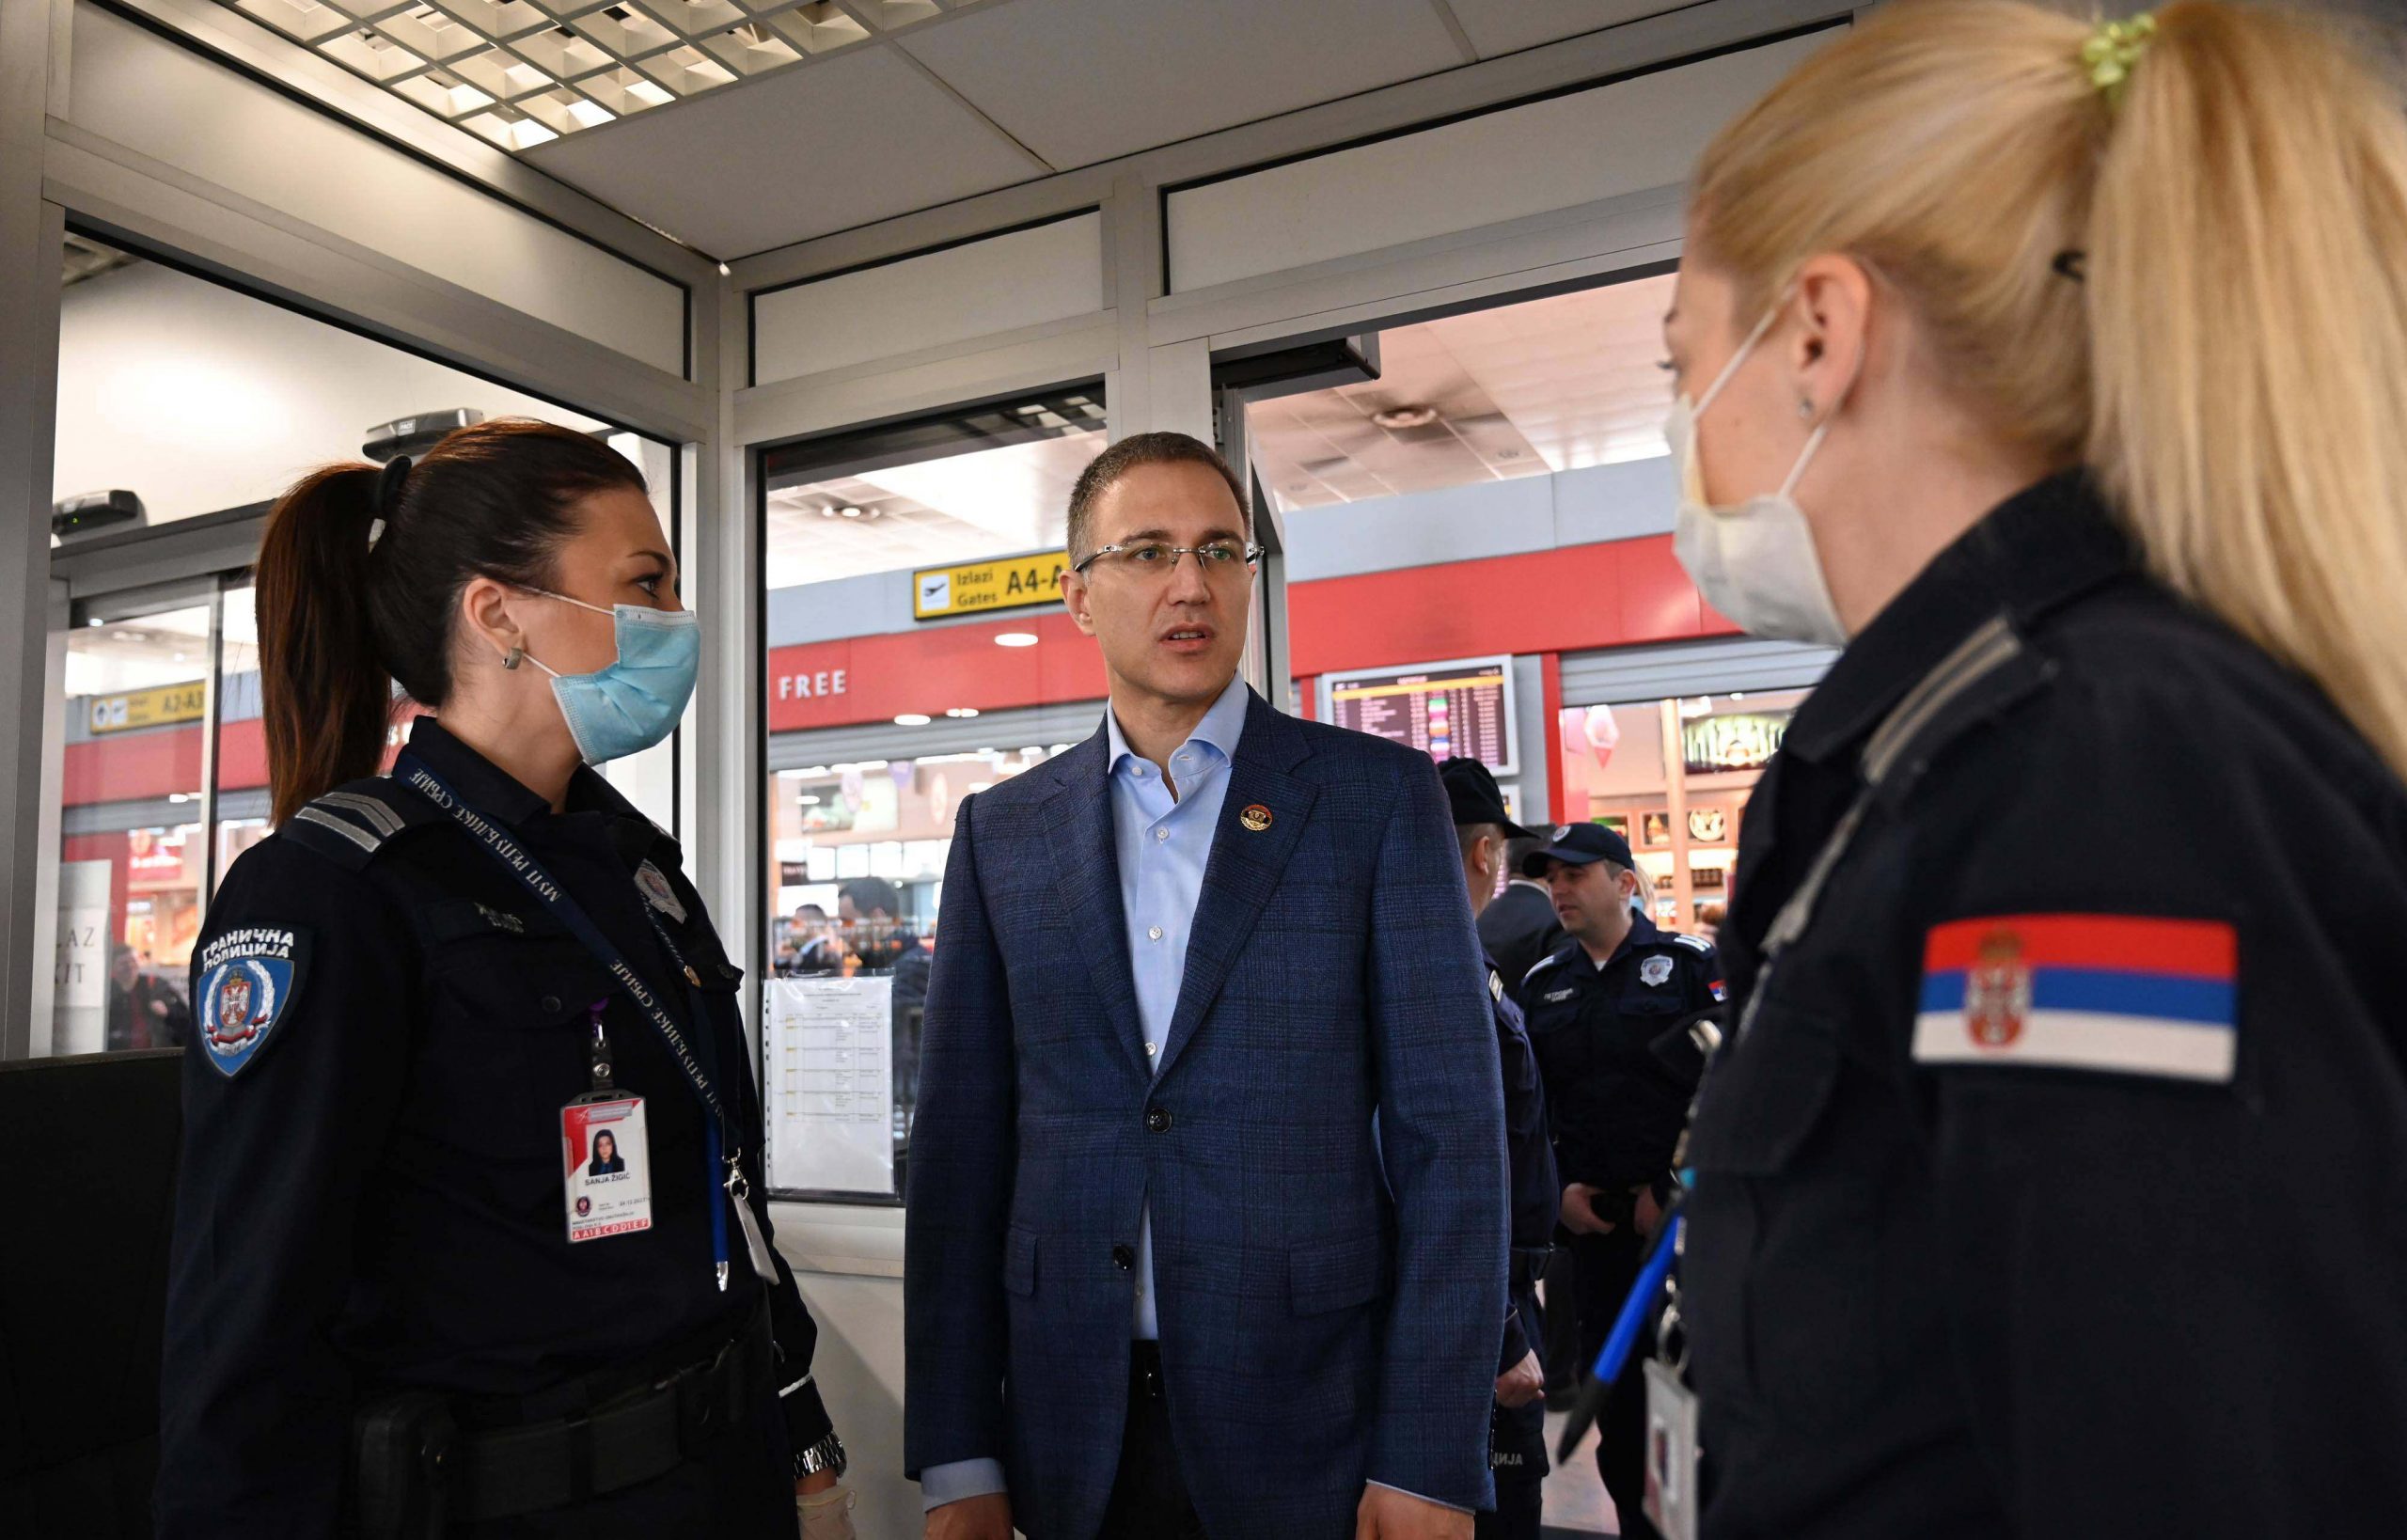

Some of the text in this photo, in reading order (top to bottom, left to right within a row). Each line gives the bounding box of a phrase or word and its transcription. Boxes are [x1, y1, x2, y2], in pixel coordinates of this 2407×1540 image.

[956, 568, 994, 587] Izlazi
[957, 591, 998, 607] Gates
[779, 669, 847, 700] FREE
[408, 767, 562, 904] МУП РЕПУБЛИКЕ СРБИЈЕ
[56, 926, 95, 948] AZ
[201, 928, 294, 963] ГРАНИЧНА
[203, 942, 290, 973] ПОЛИЦИЈА
[608, 959, 653, 1009] СРБИЈЕ
[585, 1176, 609, 1186] SANJA
